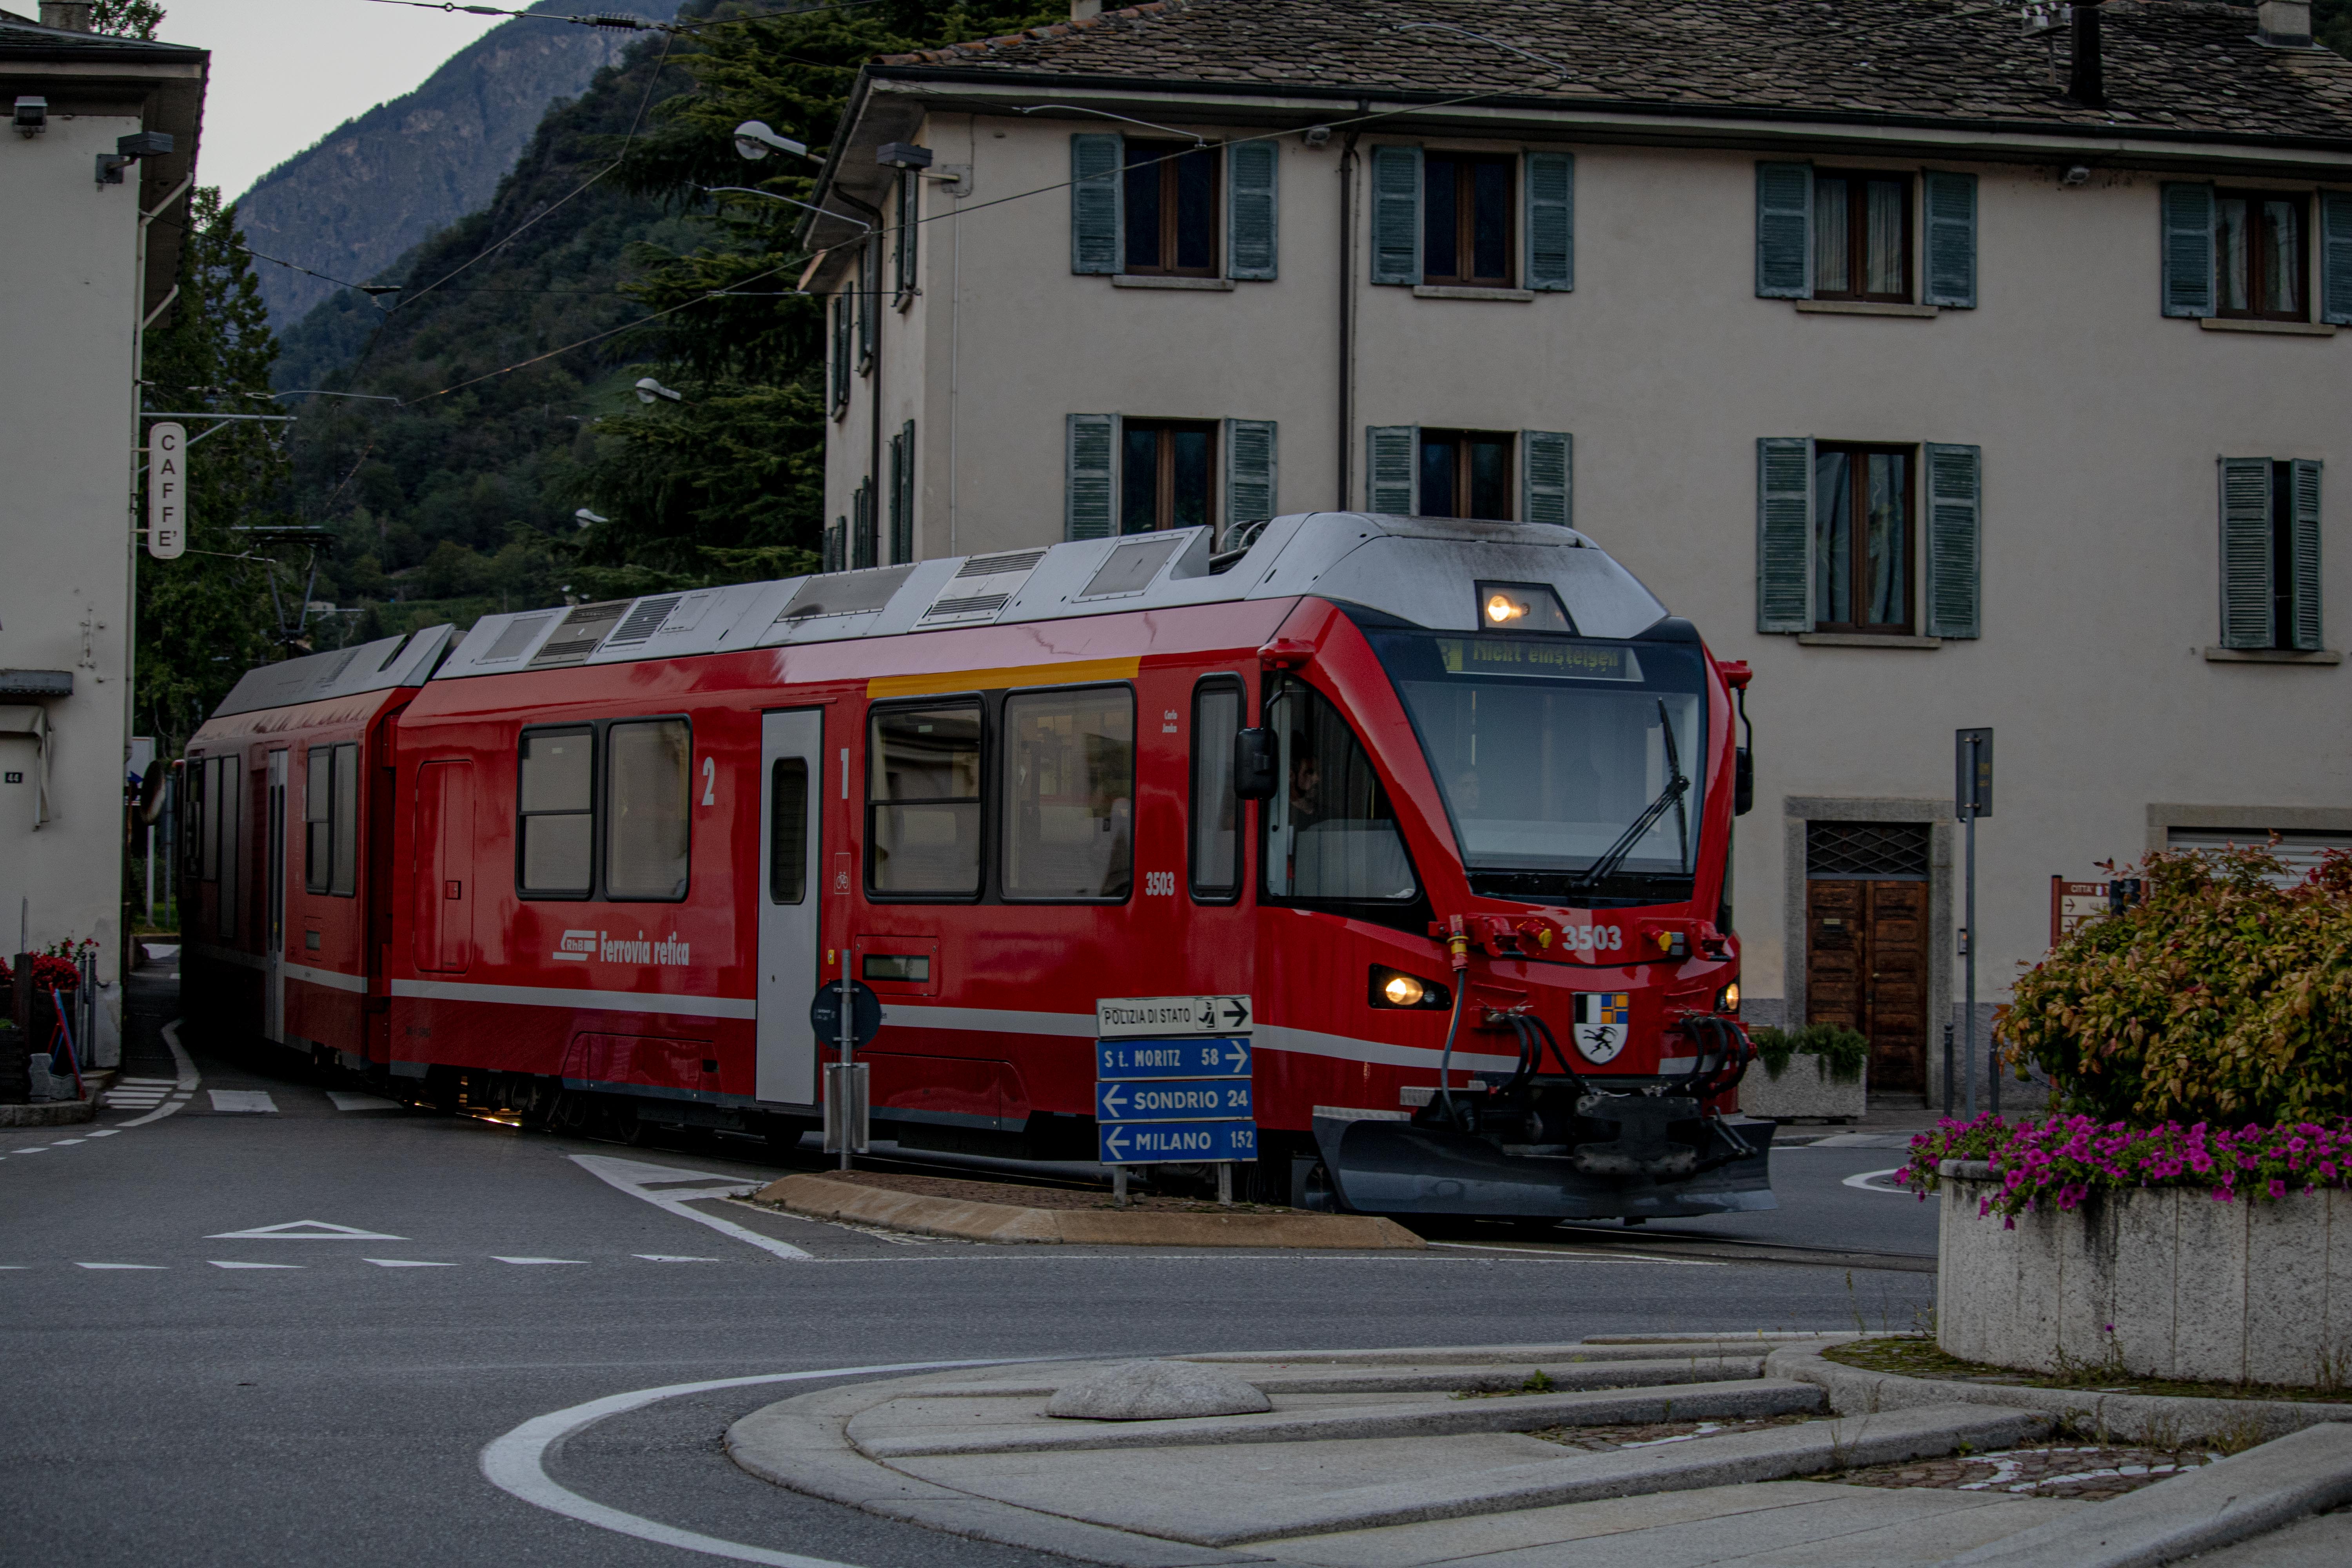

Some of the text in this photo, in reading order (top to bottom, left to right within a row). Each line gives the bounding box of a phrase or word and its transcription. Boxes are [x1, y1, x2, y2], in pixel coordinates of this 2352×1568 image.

[7, 773, 19, 782] 44
[701, 756, 716, 806] 2
[840, 748, 850, 800] 1
[1145, 871, 1175, 896] 3503
[566, 938, 584, 951] RhB
[1561, 925, 1622, 951] 3503
[654, 931, 690, 966] retica
[1104, 1008, 1191, 1025] POLIZIA DI STATO
[1134, 1049, 1181, 1067] MORITZ
[1201, 1048, 1219, 1065] 58
[1134, 1090, 1248, 1110] SONDRIO 24
[1136, 1131, 1253, 1151] MILANO 152
